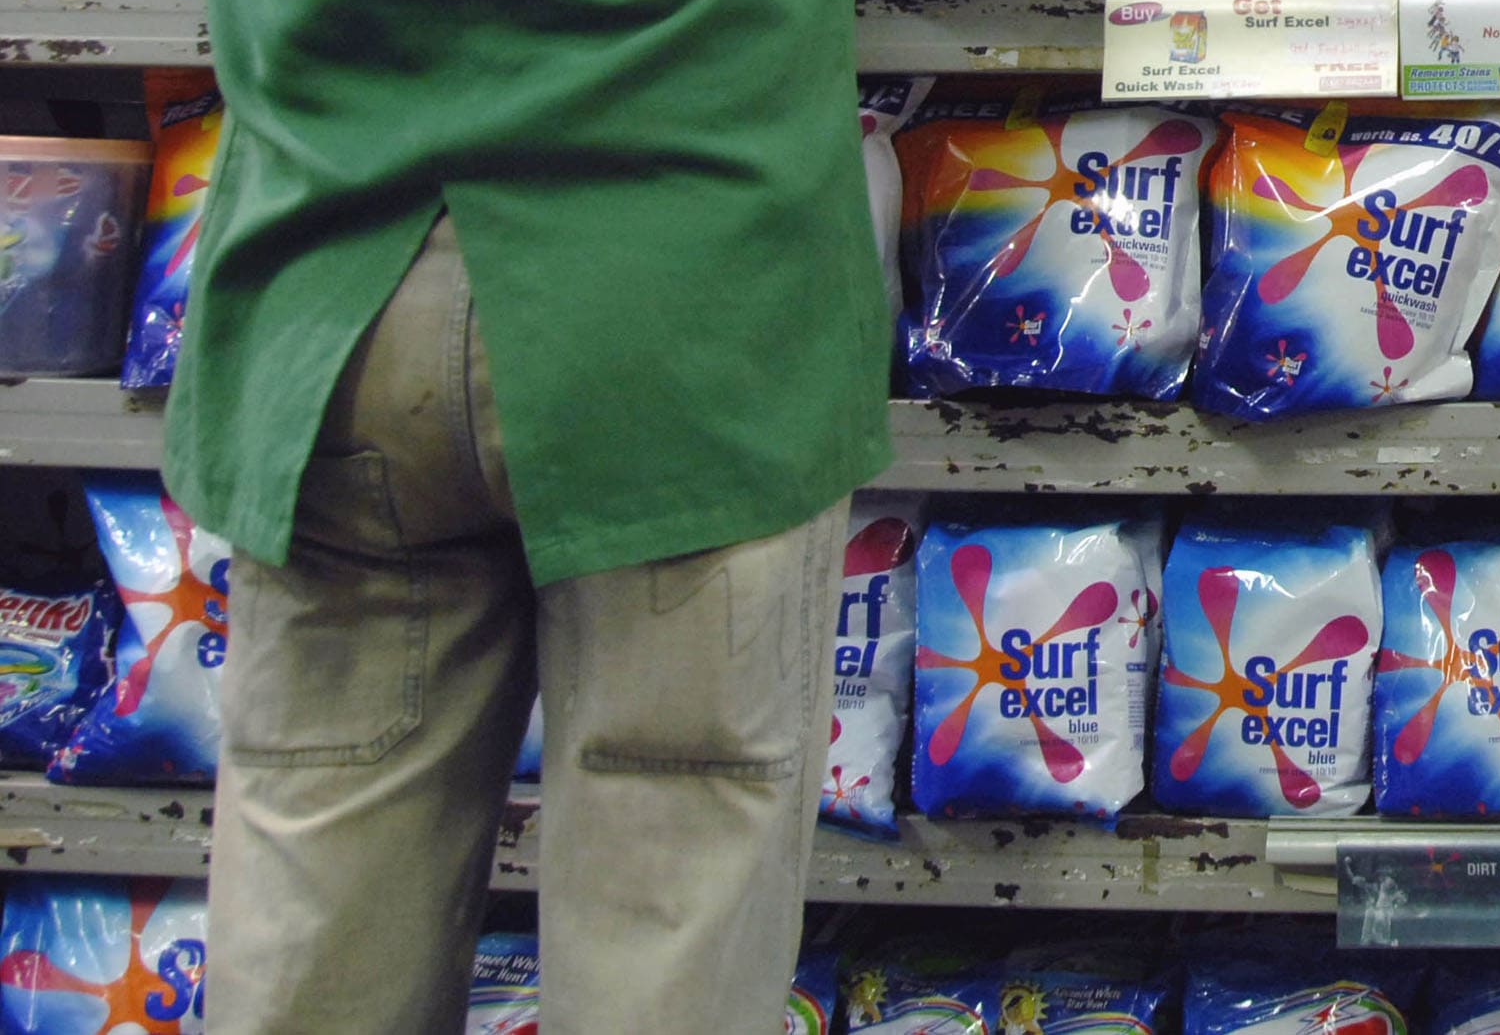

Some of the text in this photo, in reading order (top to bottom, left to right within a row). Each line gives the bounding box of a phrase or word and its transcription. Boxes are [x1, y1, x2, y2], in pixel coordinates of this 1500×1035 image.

[1120, 6, 1155, 23] Buy
[1245, 16, 1279, 29] Surf
[1284, 15, 1330, 29] Excel
[1483, 26, 1500, 39] No
[1142, 65, 1221, 77] Surf Excel
[1410, 67, 1491, 79] Removes Stains
[1115, 81, 1159, 94] Quick
[1163, 81, 1204, 93] Wash
[1409, 80, 1466, 93] PROTECTS
[1350, 129, 1394, 142] worth
[1073, 151, 1183, 204] Surf
[1070, 203, 1175, 241] excel
[1356, 188, 1469, 262] Surf
[1109, 237, 1168, 254] quickwash
[1346, 246, 1450, 299] excel
[1381, 290, 1438, 314] quickwash
[1000, 626, 1102, 681] Surf
[1242, 655, 1348, 710] Surf
[999, 678, 1098, 719] excel
[1068, 719, 1098, 734] blue
[1240, 709, 1340, 749] excel
[1308, 750, 1336, 766] blue
[1467, 862, 1497, 876] DIRT
